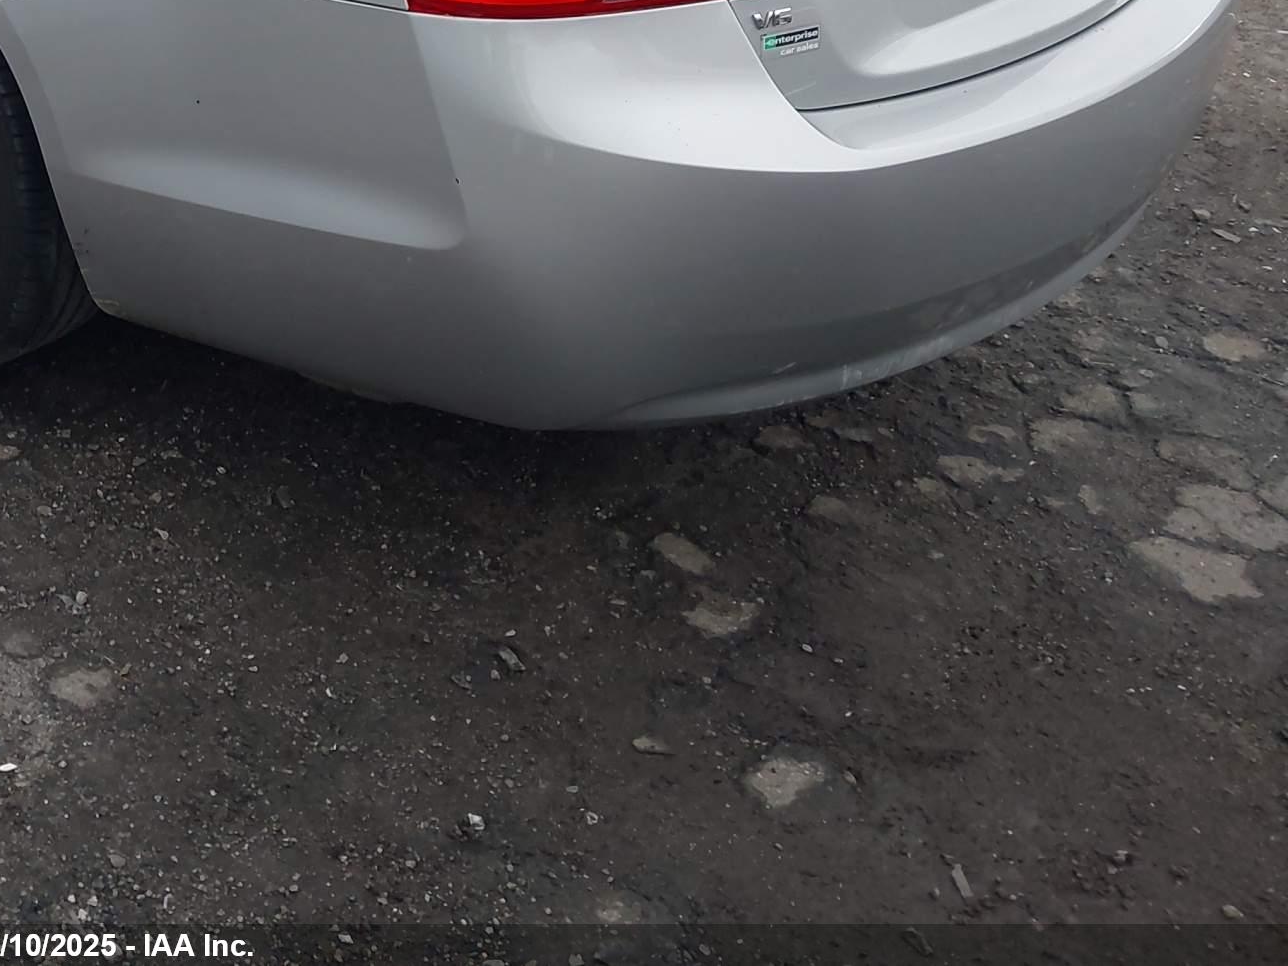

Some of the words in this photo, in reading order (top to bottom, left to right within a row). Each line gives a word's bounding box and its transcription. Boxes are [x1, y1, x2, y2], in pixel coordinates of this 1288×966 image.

[752, 7, 793, 30] V6
[766, 30, 818, 46] enterprise
[780, 47, 795, 56] car
[796, 41, 819, 53] sales
